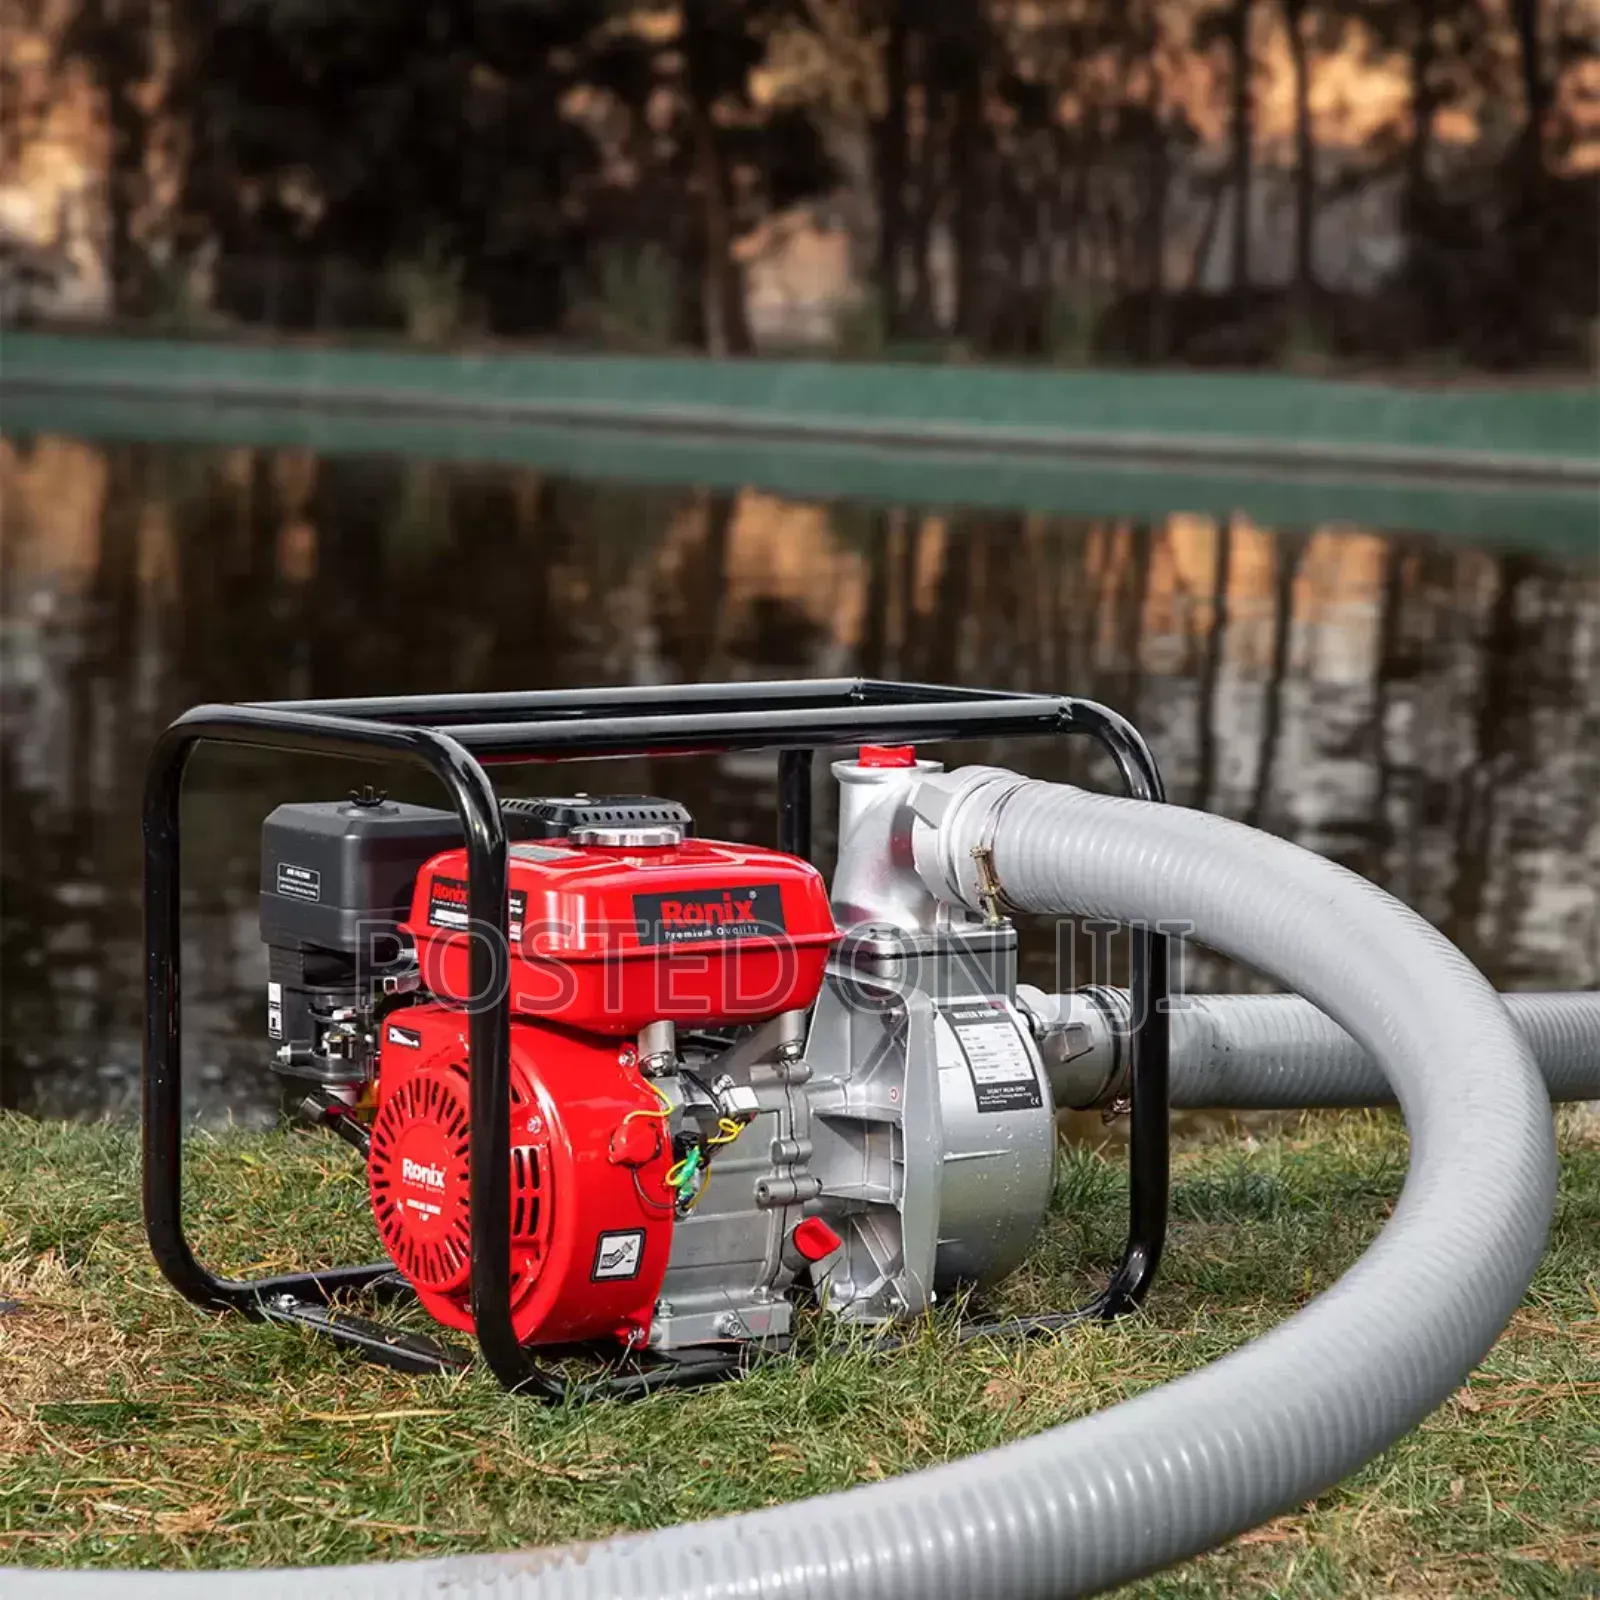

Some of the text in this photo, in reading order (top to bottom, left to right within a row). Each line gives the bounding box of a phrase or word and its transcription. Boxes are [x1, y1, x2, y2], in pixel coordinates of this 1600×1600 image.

[433, 883, 469, 904] Ronix
[660, 891, 756, 930] Ronix
[664, 925, 760, 940] Premium Quality
[402, 1157, 446, 1189] Ronix
